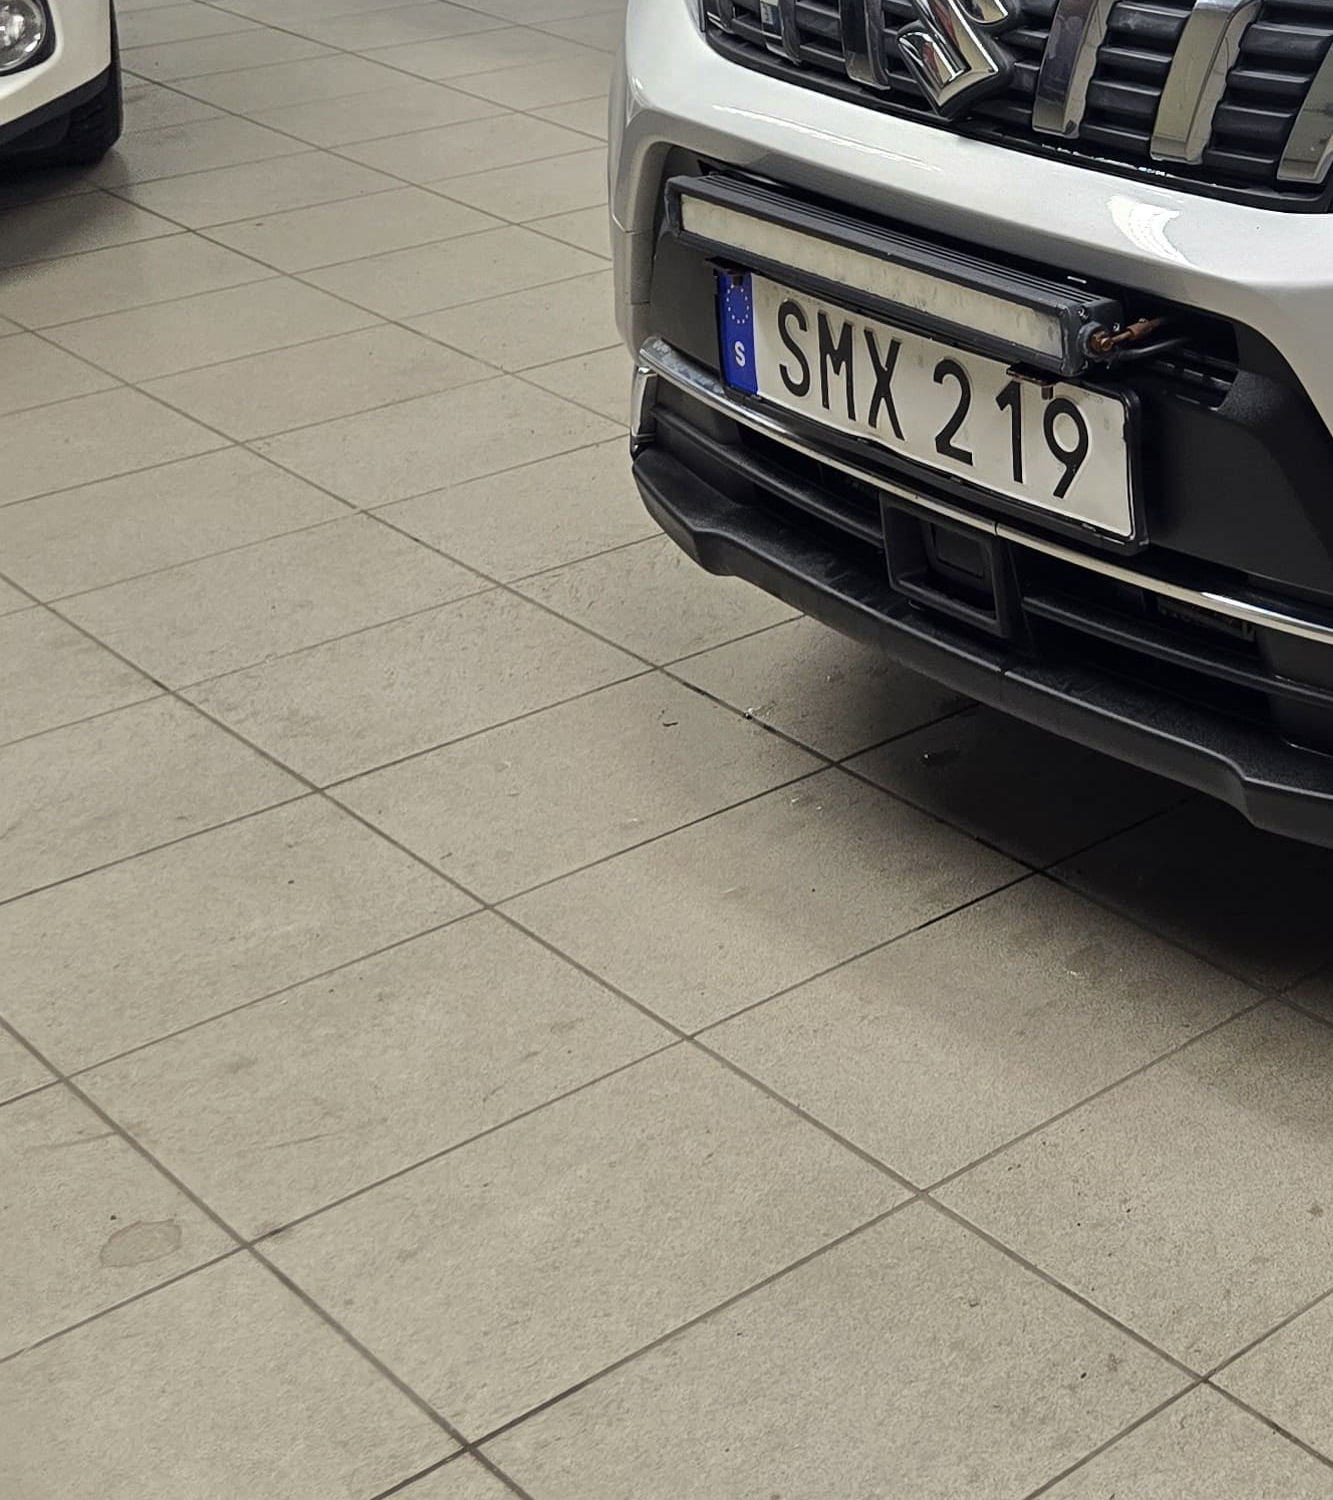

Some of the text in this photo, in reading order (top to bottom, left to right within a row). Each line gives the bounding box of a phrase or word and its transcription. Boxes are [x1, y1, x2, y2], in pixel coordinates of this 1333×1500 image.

[735, 340, 746, 367] S
[777, 299, 1089, 499] SMX 219
